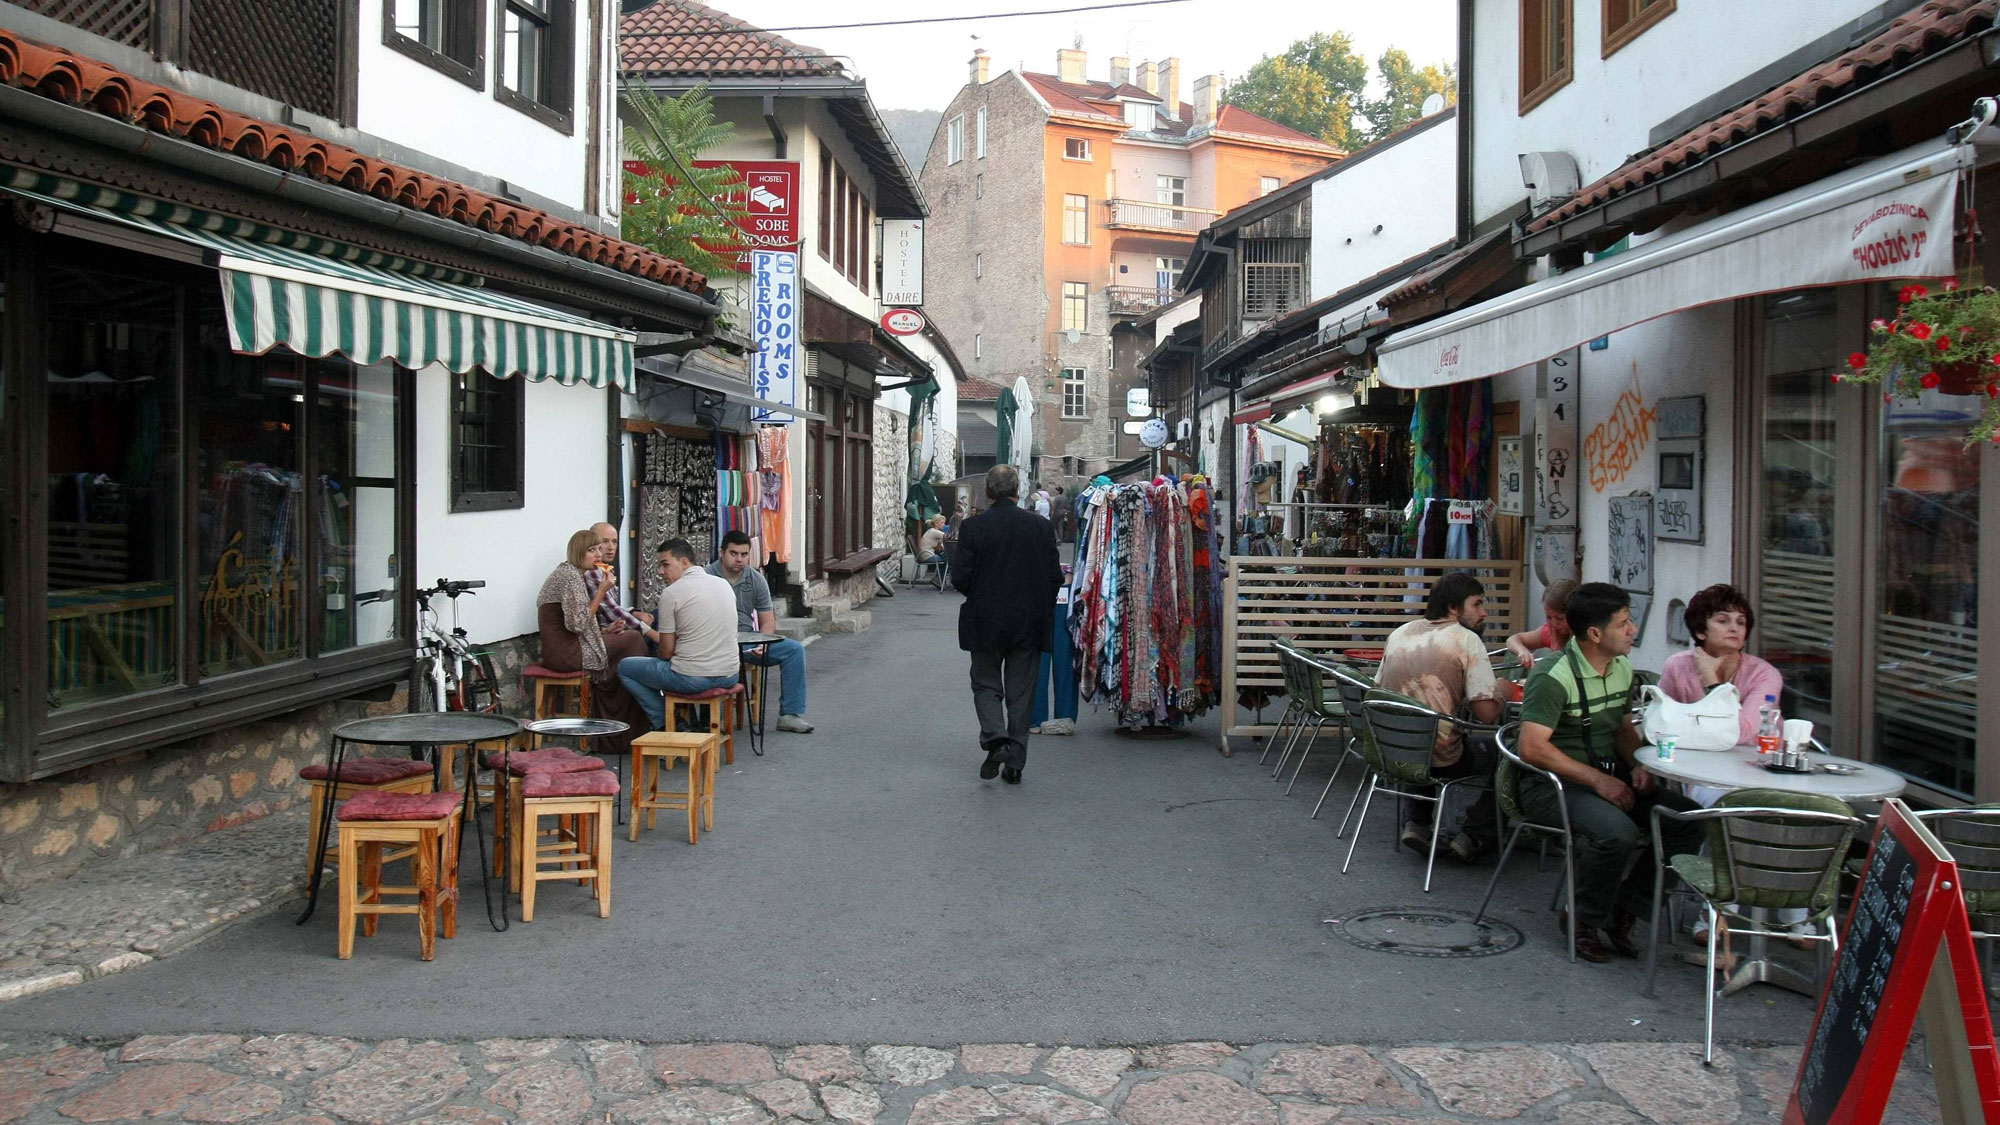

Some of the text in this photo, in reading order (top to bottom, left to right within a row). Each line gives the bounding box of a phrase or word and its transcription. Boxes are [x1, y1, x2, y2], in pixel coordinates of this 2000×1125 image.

[759, 175, 783, 183] HOSTEL
[756, 219, 789, 231] SOBE
[899, 230, 909, 287] HOSTEL
[886, 292, 919, 303] DAIRE
[774, 283, 792, 380] ROOMS
[1583, 360, 1642, 463] PROTIV
